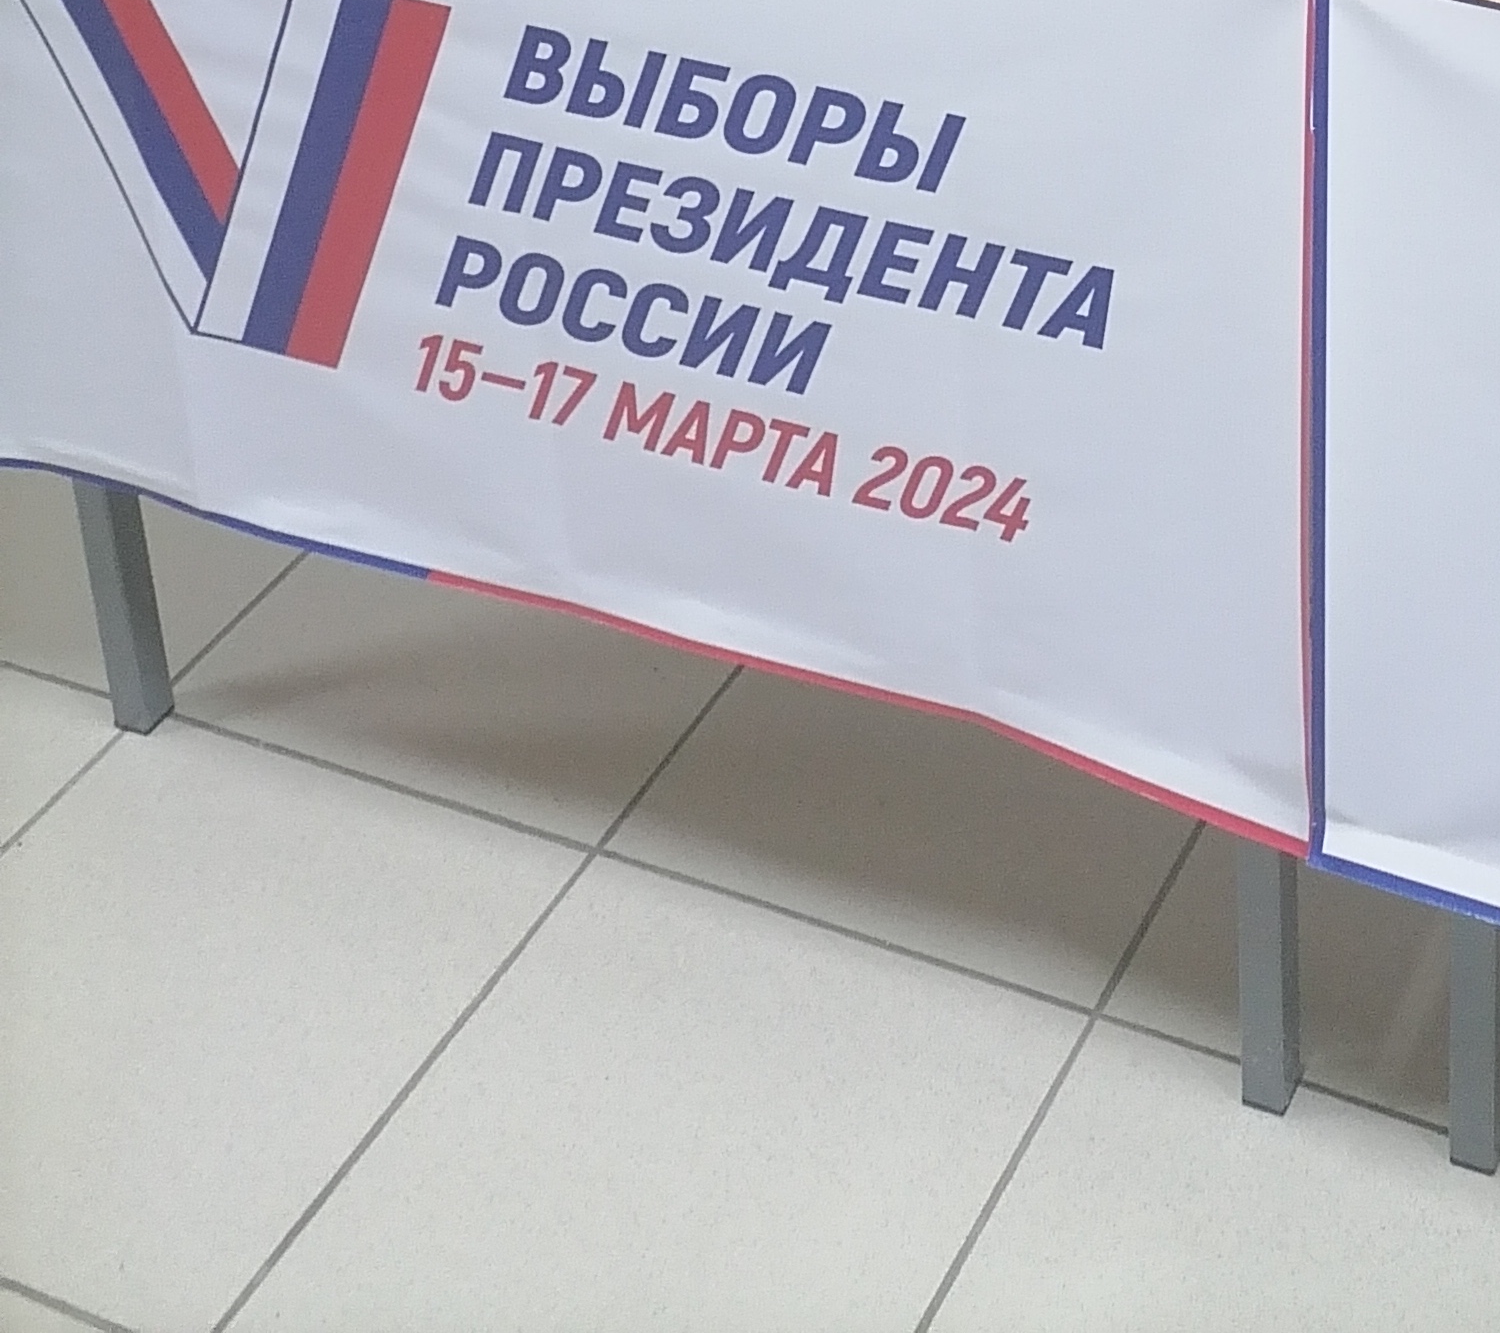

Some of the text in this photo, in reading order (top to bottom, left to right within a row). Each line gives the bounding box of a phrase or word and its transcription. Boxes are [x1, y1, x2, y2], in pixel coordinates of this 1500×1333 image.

[502, 23, 967, 194] ВЫБОРЫ
[435, 235, 833, 396] РОССИИ
[467, 131, 1117, 351] ПРЕЗИДЕНТА
[603, 381, 839, 498] МАРТА
[852, 445, 1031, 543] 2024
